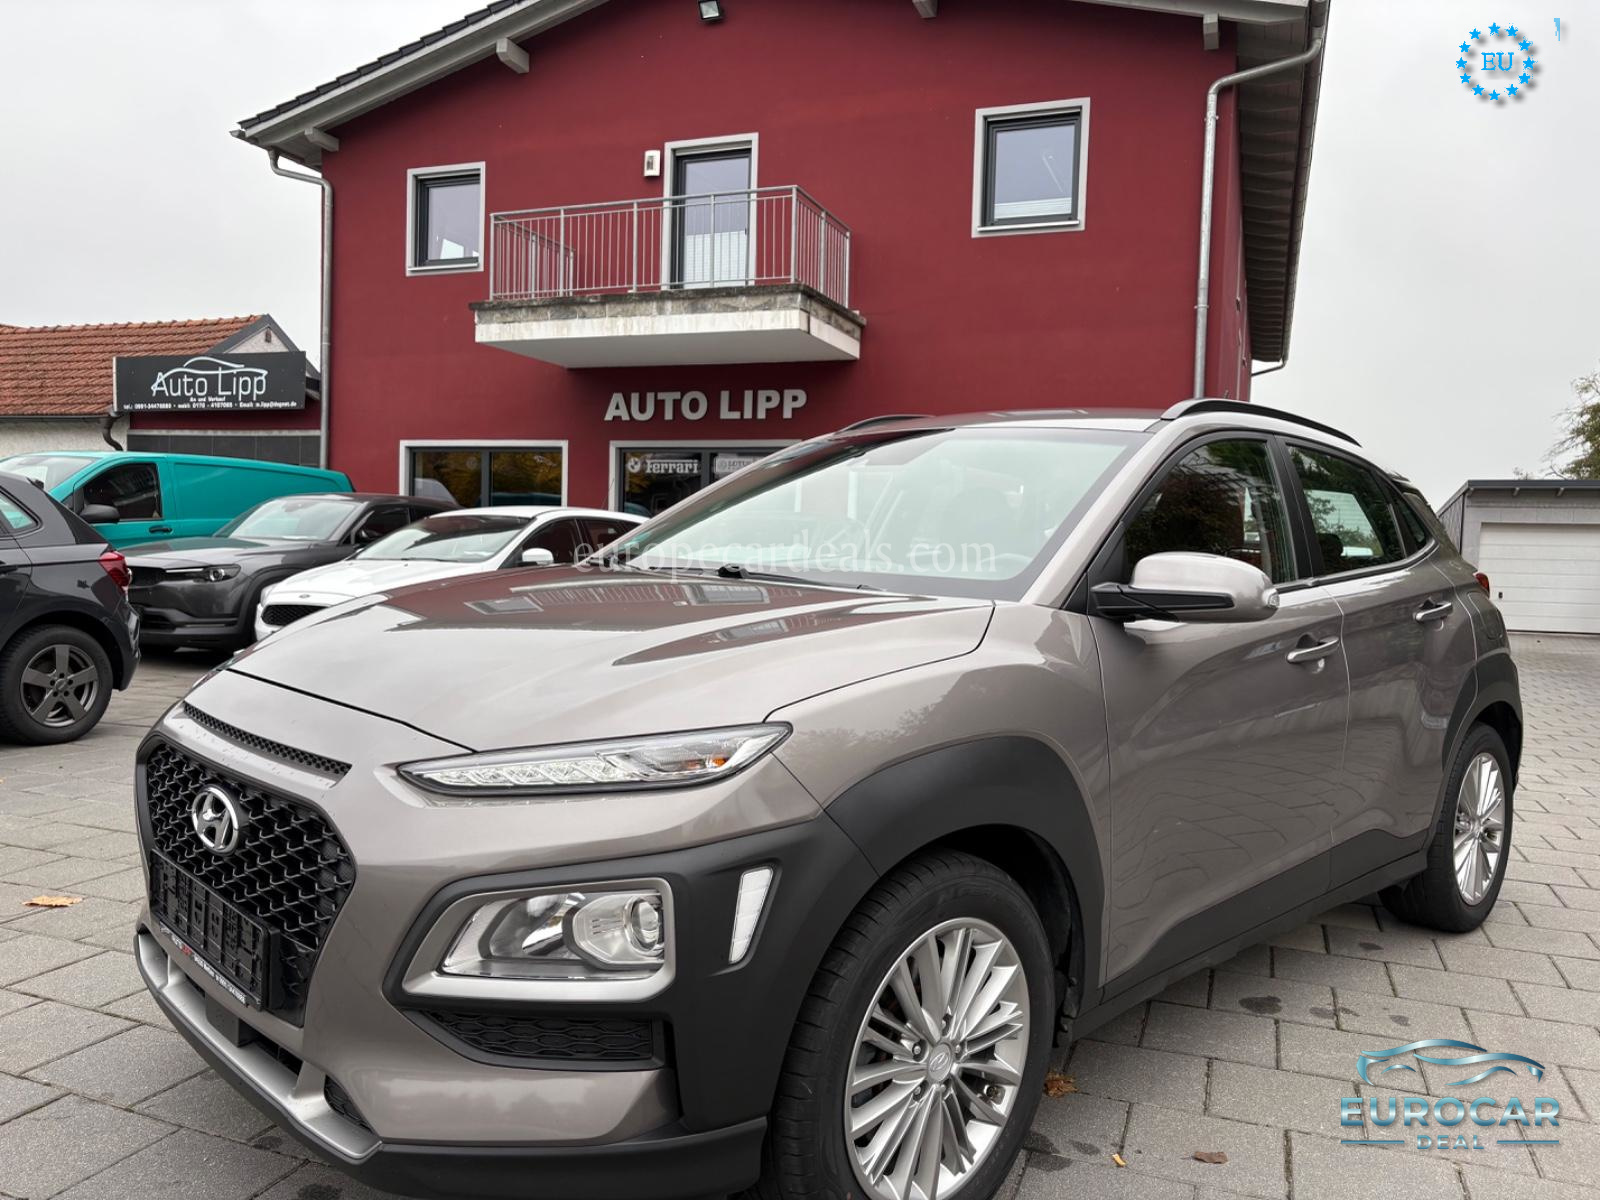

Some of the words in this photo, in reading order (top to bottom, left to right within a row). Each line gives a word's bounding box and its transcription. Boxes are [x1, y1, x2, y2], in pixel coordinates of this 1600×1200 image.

[151, 371, 208, 397] Auto
[217, 366, 267, 401] Lipp
[604, 390, 708, 421] AUTO
[720, 388, 807, 420] LIPP
